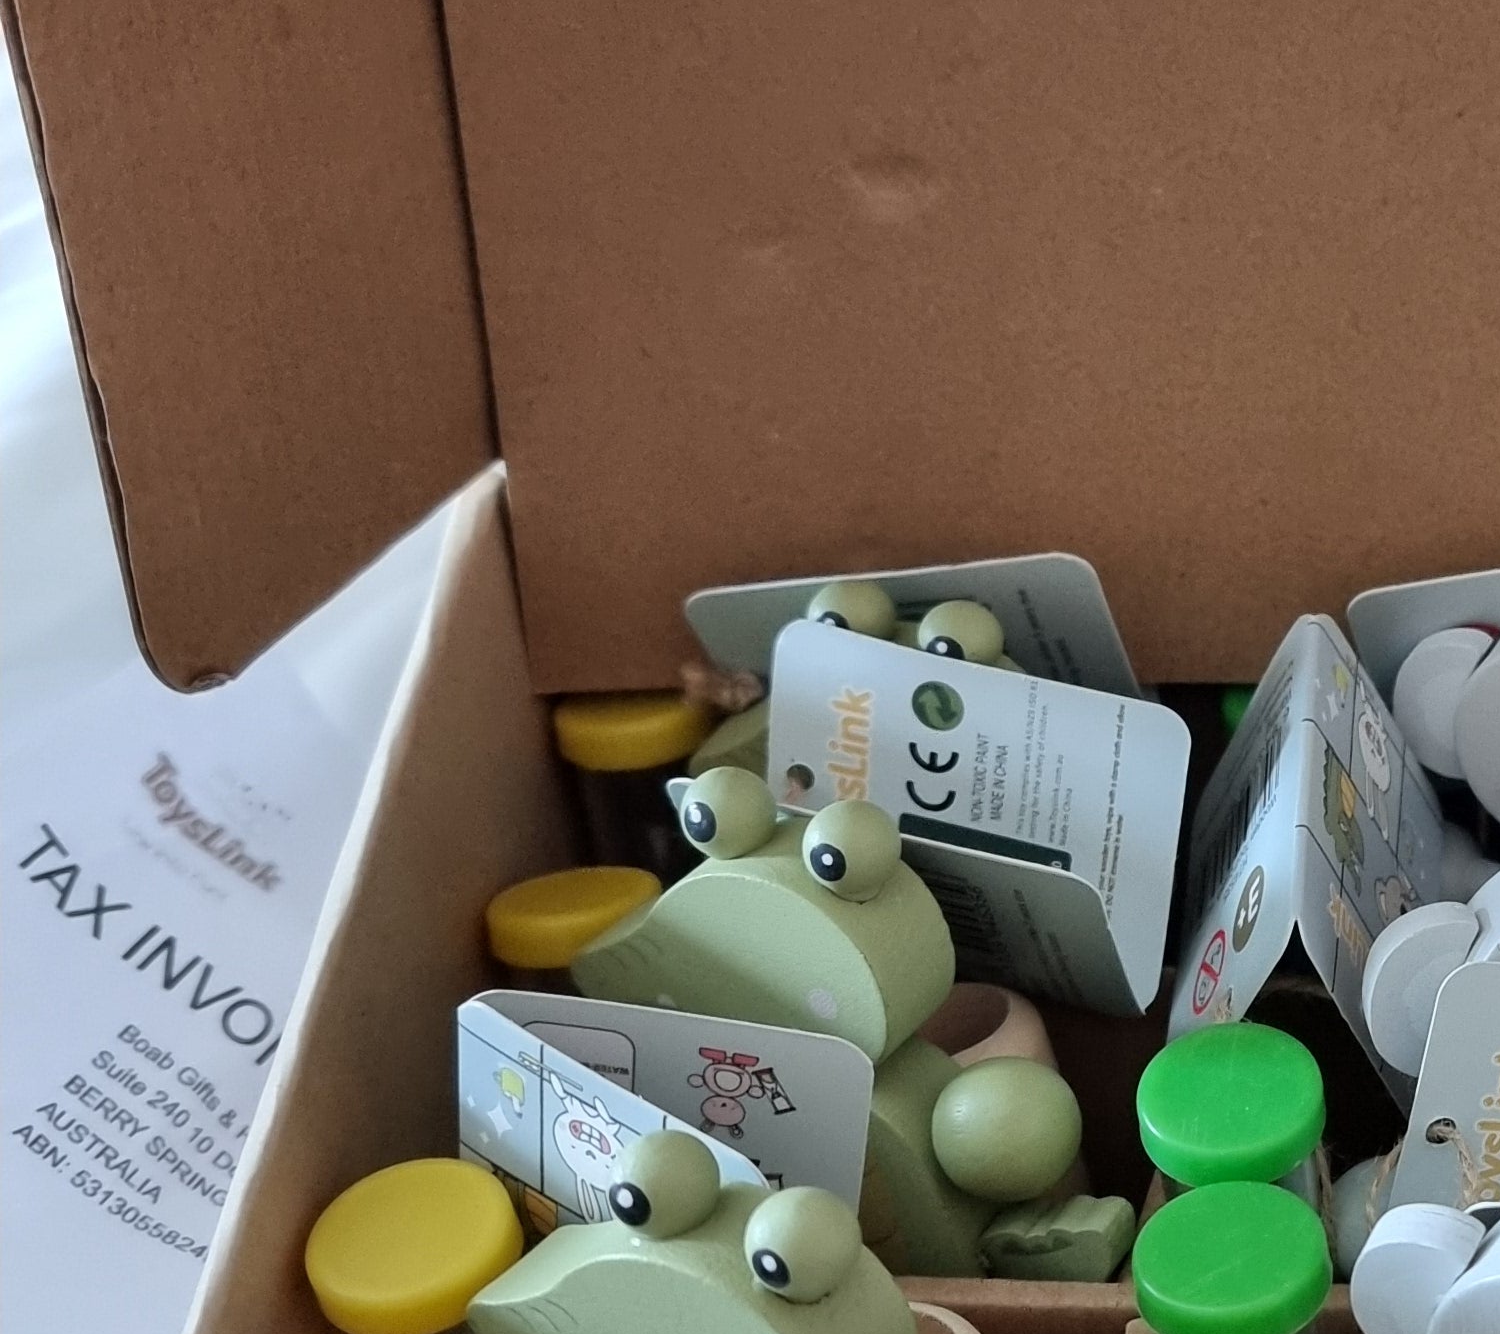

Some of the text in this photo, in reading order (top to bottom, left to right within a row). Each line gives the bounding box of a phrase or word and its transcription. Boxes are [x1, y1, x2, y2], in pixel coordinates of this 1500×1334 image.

[828, 686, 871, 801] sLink
[19, 823, 131, 940] TAX
[122, 925, 281, 1066] INVOI
[117, 1024, 174, 1072] Boab
[36, 1101, 164, 1205] AUSTRALIA
[62, 1074, 146, 1139] BERRY
[91, 1050, 153, 1100] Suite
[153, 1090, 190, 1130] 240
[190, 1126, 214, 1156] 10
[12, 1123, 209, 1263] ABN: 5313055824
